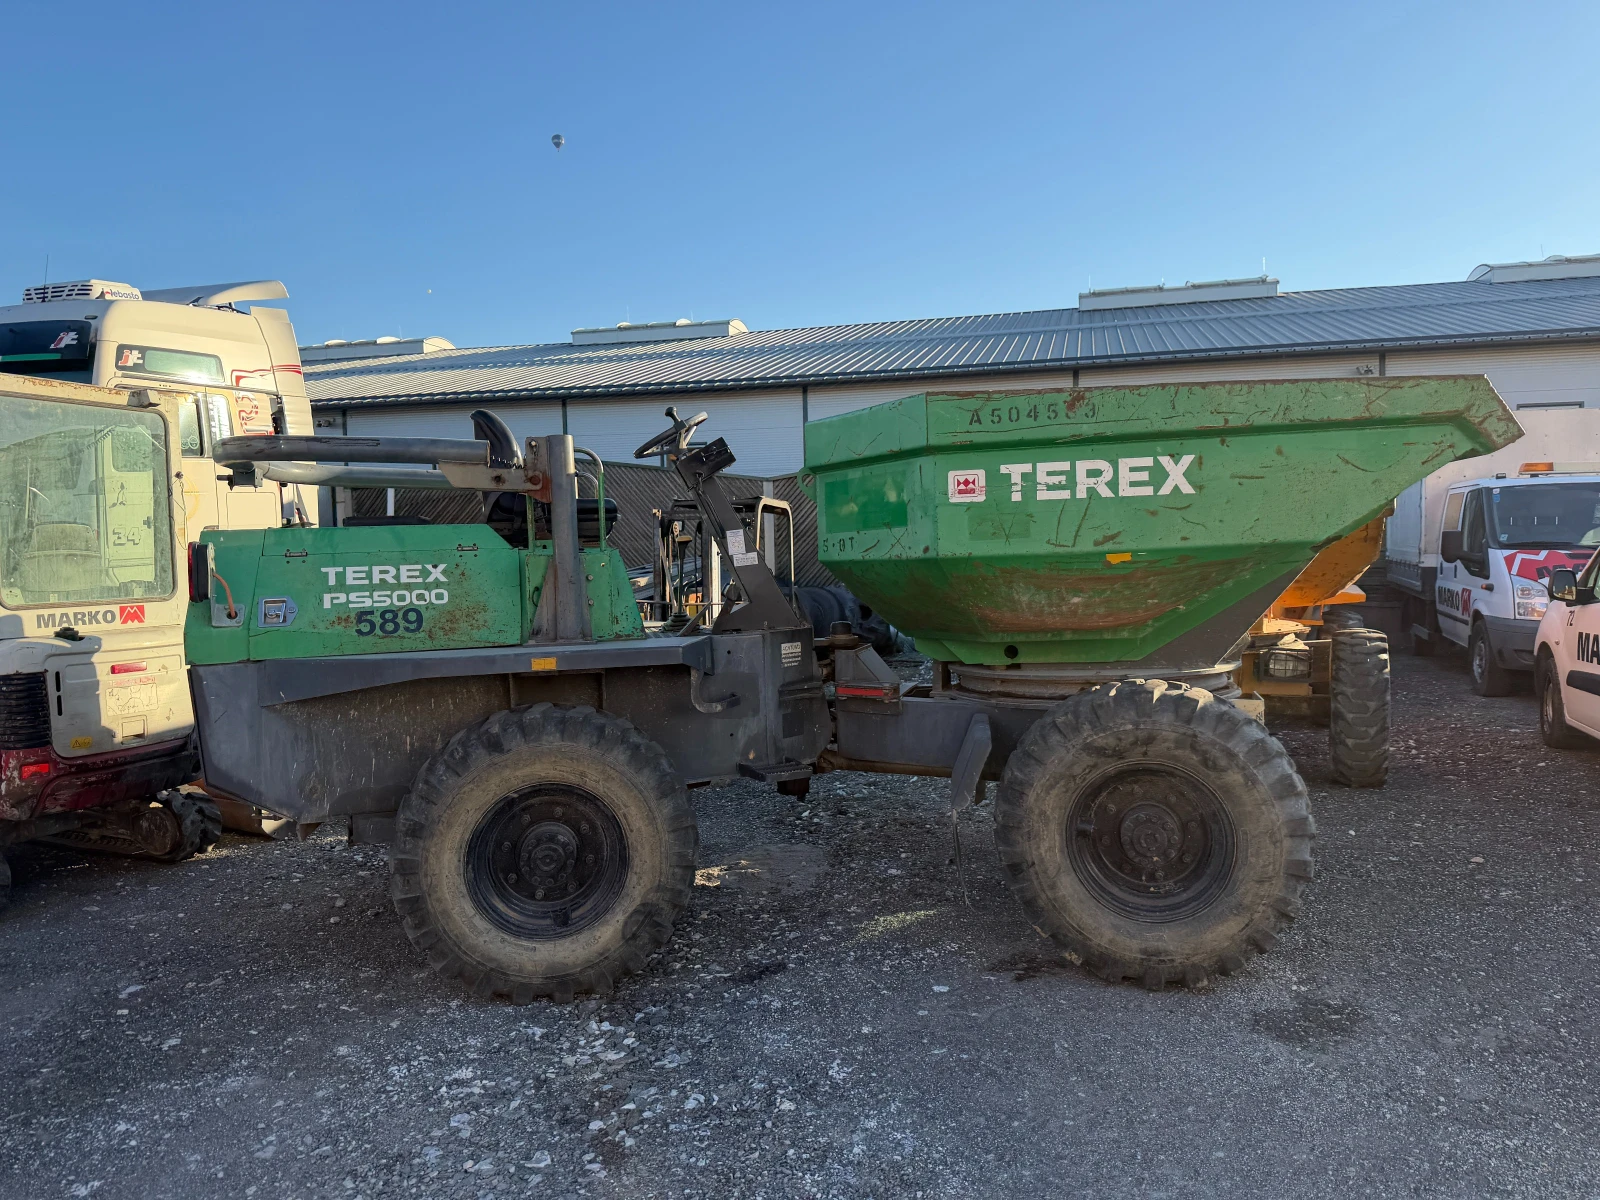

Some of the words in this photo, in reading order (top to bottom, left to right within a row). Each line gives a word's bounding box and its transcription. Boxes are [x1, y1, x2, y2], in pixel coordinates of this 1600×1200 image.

[1000, 454, 1196, 502] TEREX
[320, 563, 449, 586] TEREX
[323, 588, 449, 609] PS5000
[36, 609, 117, 629] MARKO
[354, 607, 424, 637] 589
